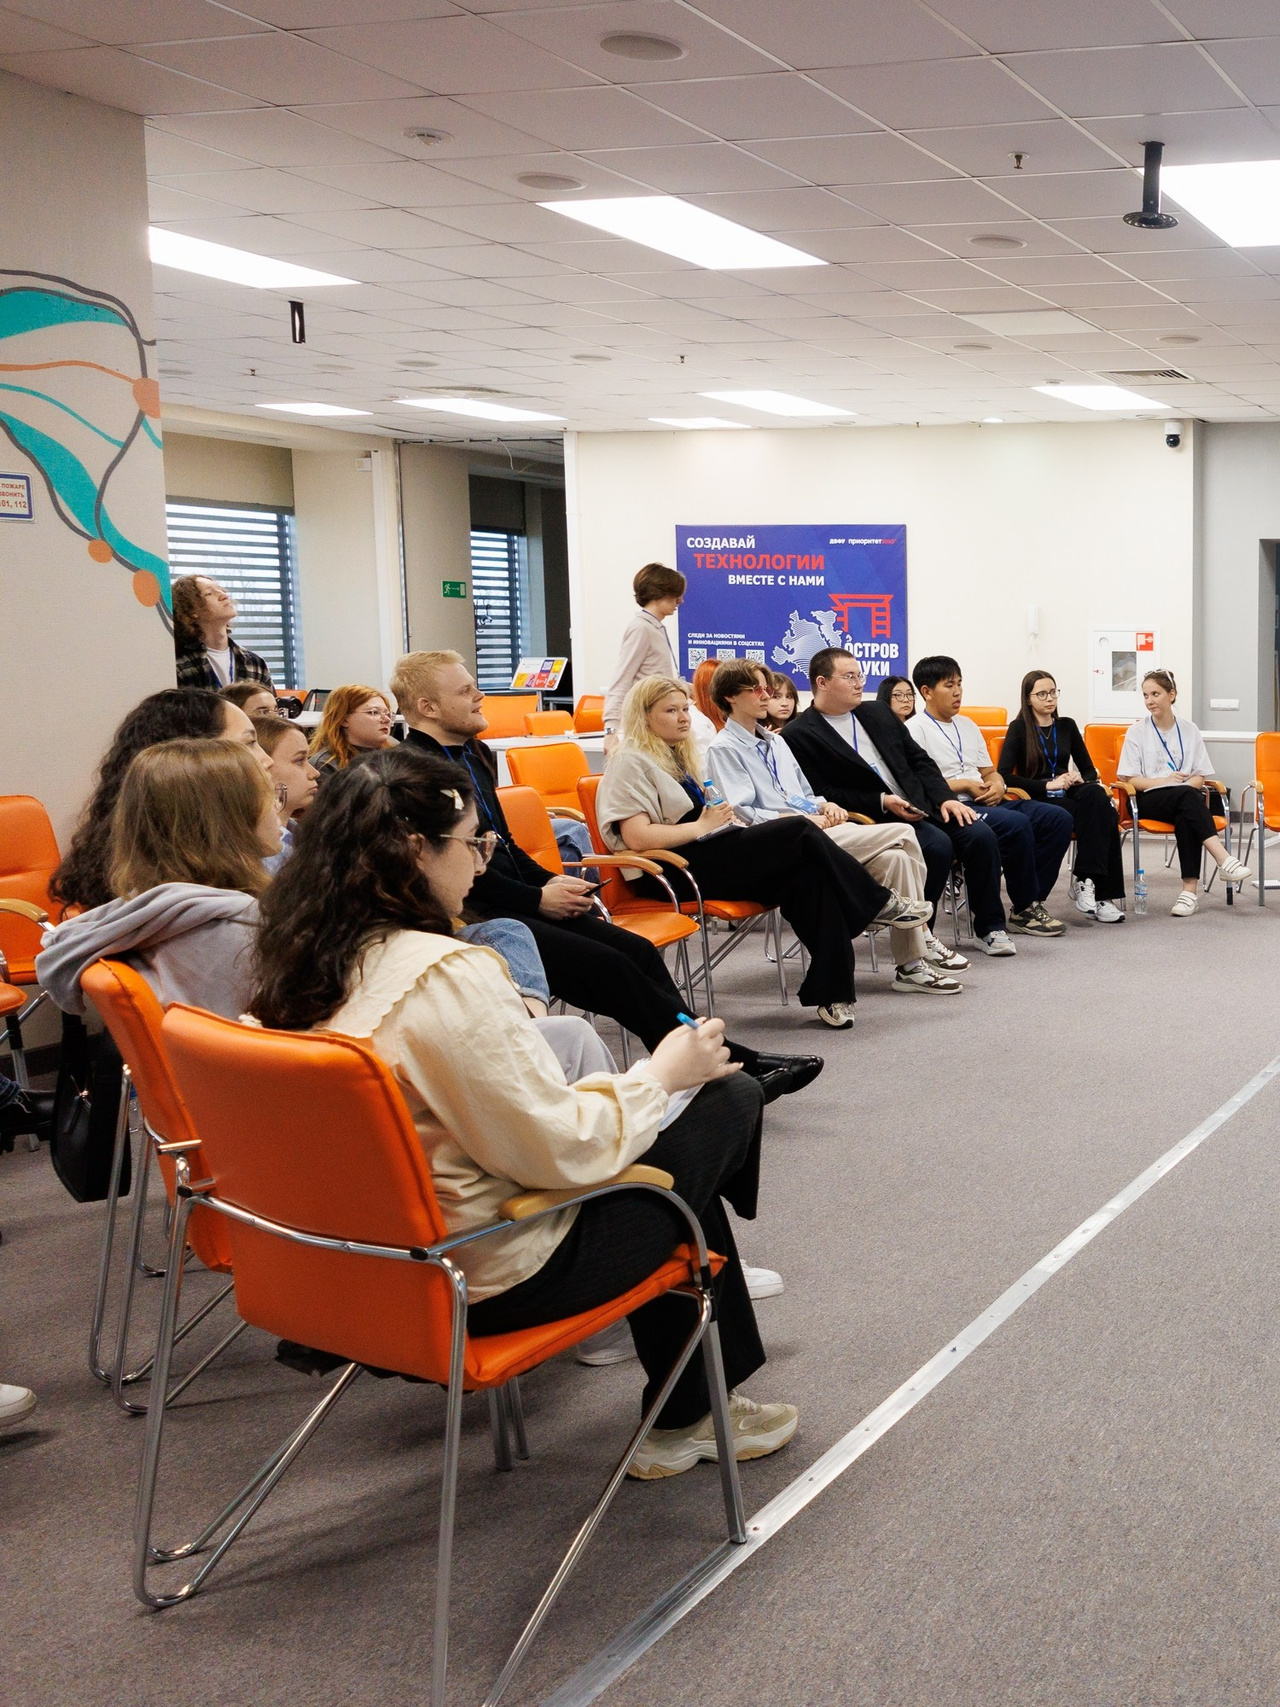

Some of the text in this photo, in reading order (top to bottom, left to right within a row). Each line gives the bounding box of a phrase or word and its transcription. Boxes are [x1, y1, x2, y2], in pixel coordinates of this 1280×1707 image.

[0, 499, 27, 509] 01, 112
[686, 535, 755, 550] СОЗДАВАЙ
[693, 553, 825, 570] ТЕХНОЛОГИИ
[728, 574, 825, 586] ВМЕСТЕ С НАМИ
[844, 642, 899, 659] ОСТРОВ
